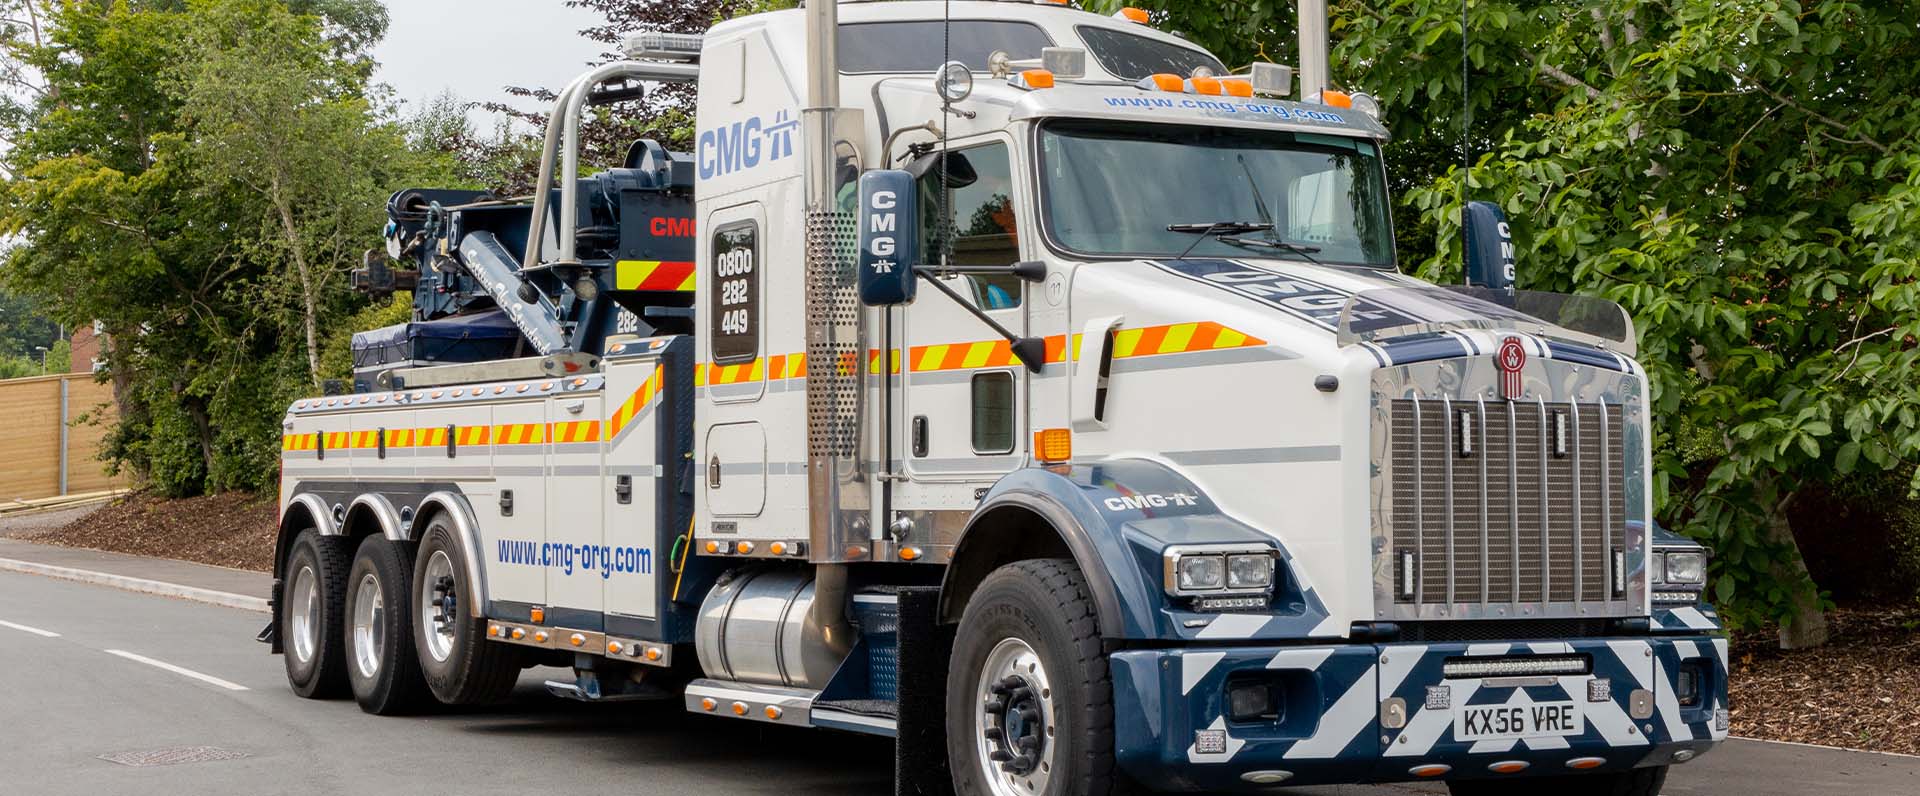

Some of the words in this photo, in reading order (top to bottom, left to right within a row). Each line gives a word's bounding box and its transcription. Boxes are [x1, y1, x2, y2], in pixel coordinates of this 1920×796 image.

[1104, 96, 1344, 123] www.cmg-org.com
[699, 117, 761, 180] CMG
[872, 191, 896, 256] CMG
[718, 249, 752, 277] 0800
[722, 279, 747, 305] 282
[1203, 272, 1361, 310] CMG
[617, 311, 637, 333] 282
[722, 309, 748, 335] 449
[1104, 494, 1168, 511] CMG
[498, 539, 651, 579] www.cmg-org.com
[1464, 708, 1524, 735] KX56
[1531, 705, 1574, 731] VRE
